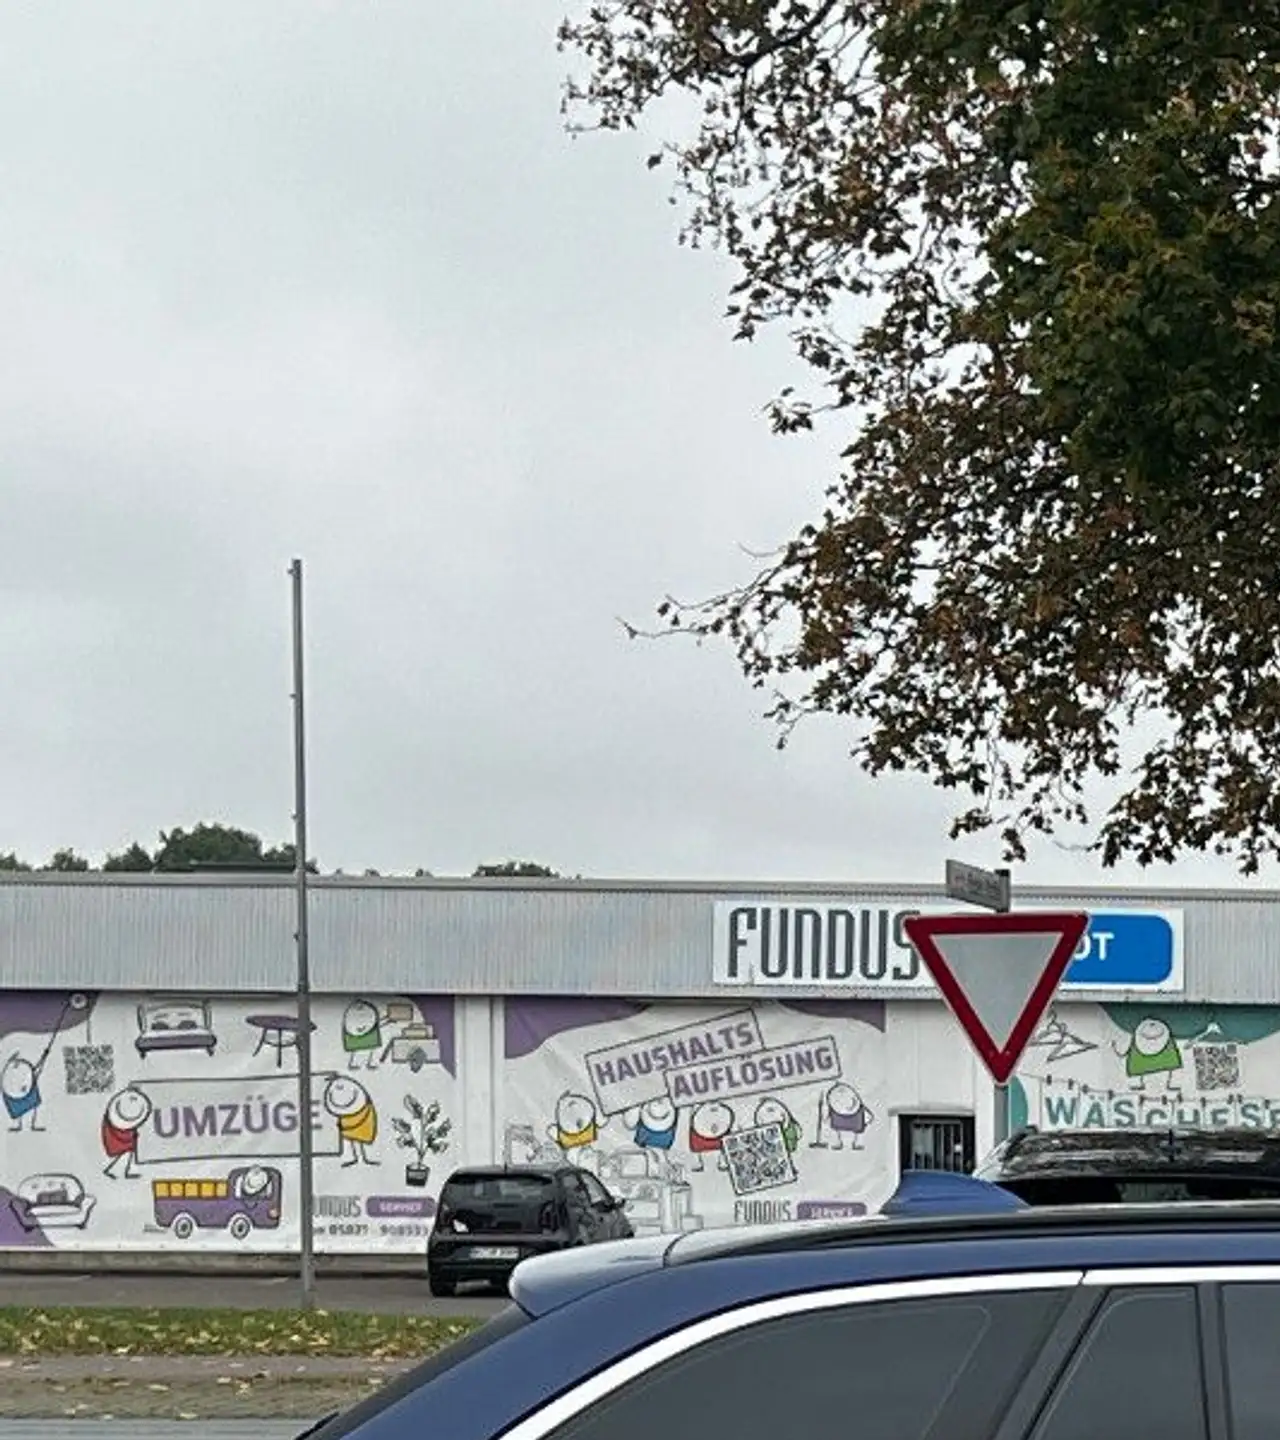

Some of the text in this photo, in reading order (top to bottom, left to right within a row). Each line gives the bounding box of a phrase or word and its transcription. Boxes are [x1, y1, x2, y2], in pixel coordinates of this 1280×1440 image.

[727, 907, 921, 980] FUNDUS
[593, 1021, 757, 1086] HAUSHALTS
[674, 1046, 833, 1099] AUFLÖSUNG
[153, 1094, 323, 1139] UMZÜGE
[734, 1199, 792, 1225] FUNDUS
